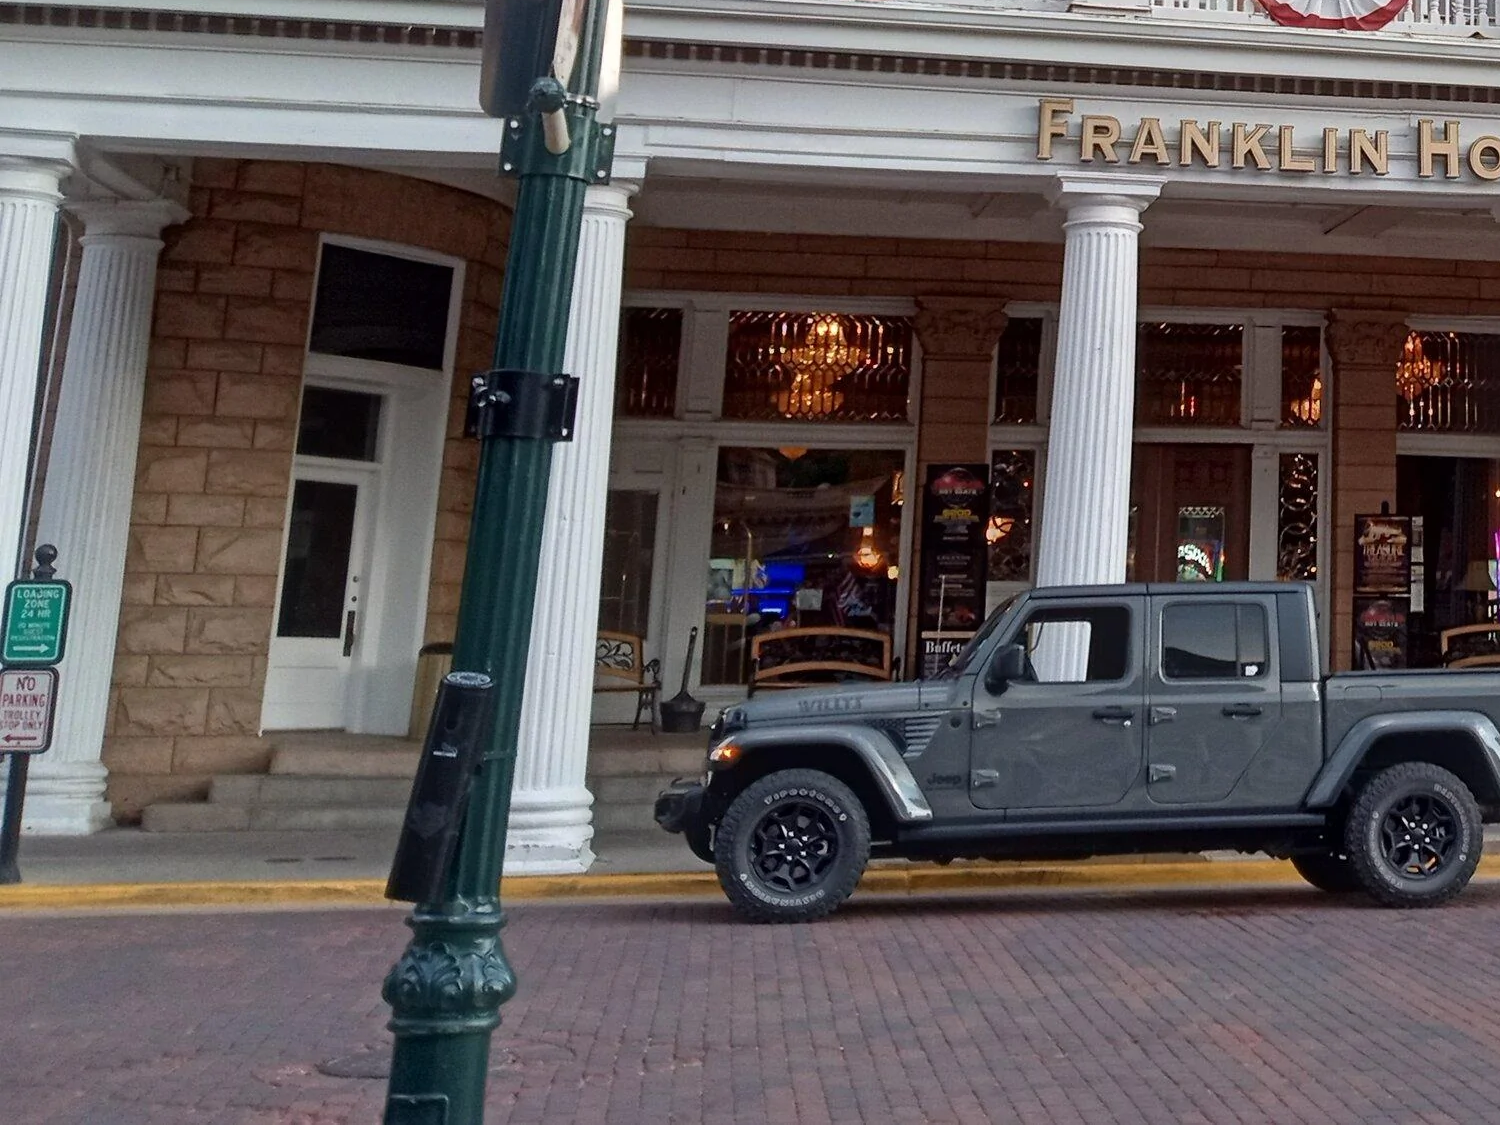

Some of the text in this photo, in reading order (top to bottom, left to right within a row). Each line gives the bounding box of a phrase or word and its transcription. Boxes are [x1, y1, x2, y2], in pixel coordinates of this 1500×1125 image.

[1036, 98, 1391, 176] FRANKLIN
[17, 589, 60, 599] LOADING
[24, 599, 50, 609] ZONE
[20, 609, 51, 619] 24 HR
[16, 676, 36, 691] NO
[2, 693, 46, 707] PARKING
[3, 709, 42, 721] TROLLEY
[0, 719, 43, 731] STOP ONLY
[926, 772, 962, 785] Jeep
